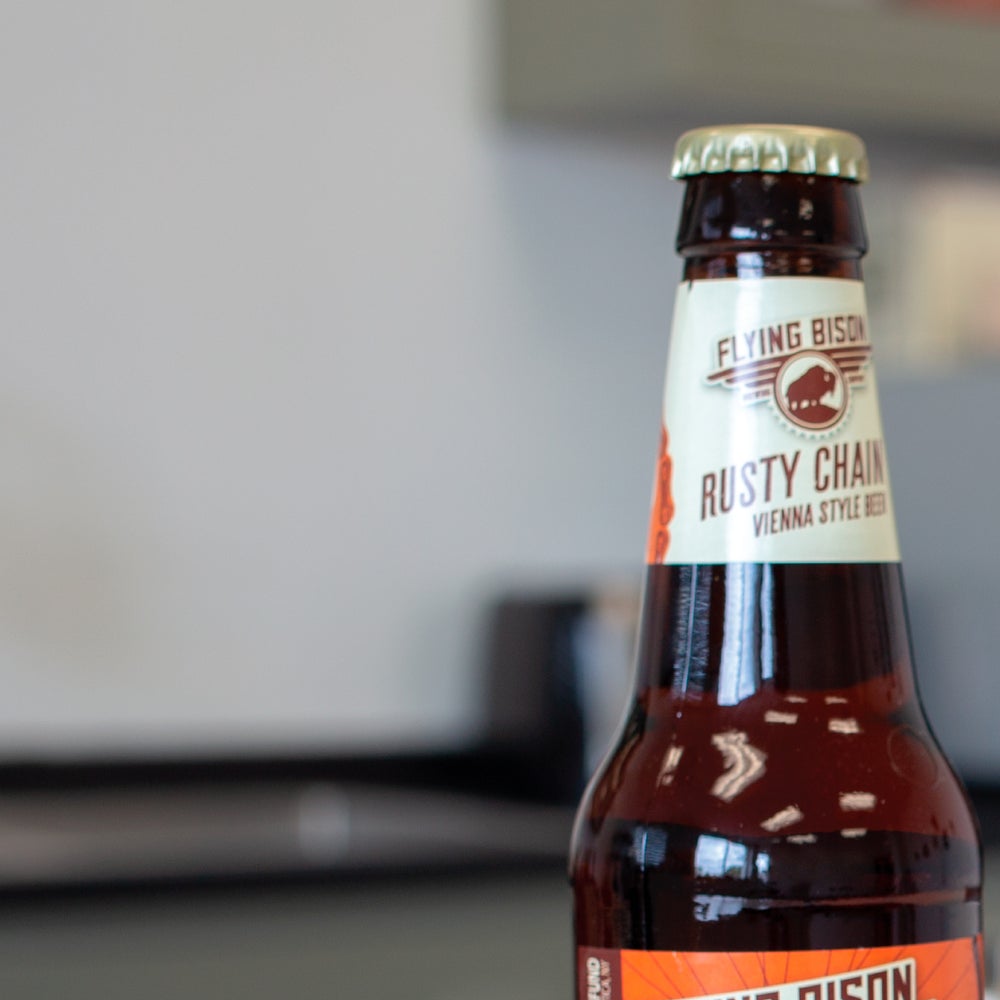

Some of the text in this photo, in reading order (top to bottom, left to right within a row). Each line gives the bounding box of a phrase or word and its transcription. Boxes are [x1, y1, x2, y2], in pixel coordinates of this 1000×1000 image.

[718, 314, 867, 367] FLYING BISON
[701, 438, 885, 521] RUSTY CHAIN
[753, 503, 814, 538] VIENNA
[819, 493, 860, 525] STYLE
